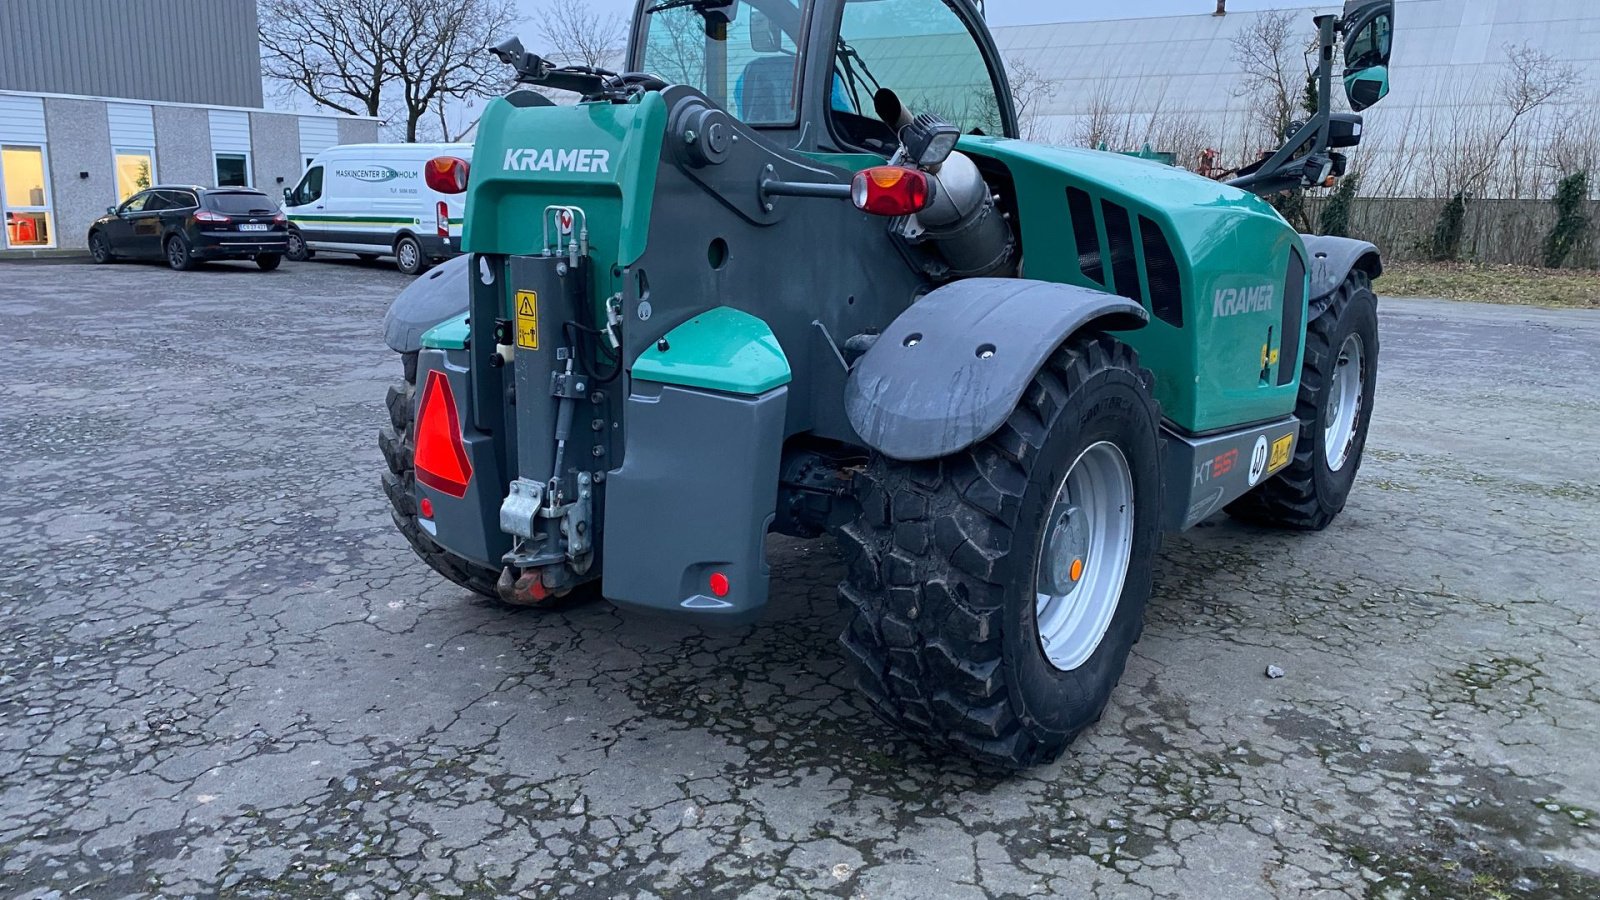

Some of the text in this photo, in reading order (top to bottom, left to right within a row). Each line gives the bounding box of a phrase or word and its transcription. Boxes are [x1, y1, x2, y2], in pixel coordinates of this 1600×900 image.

[335, 169, 418, 179] MASKINCENTER BORNHOLM
[503, 148, 609, 173] KRAMER
[1213, 284, 1274, 318] KRAMER
[1252, 445, 1264, 477] 40
